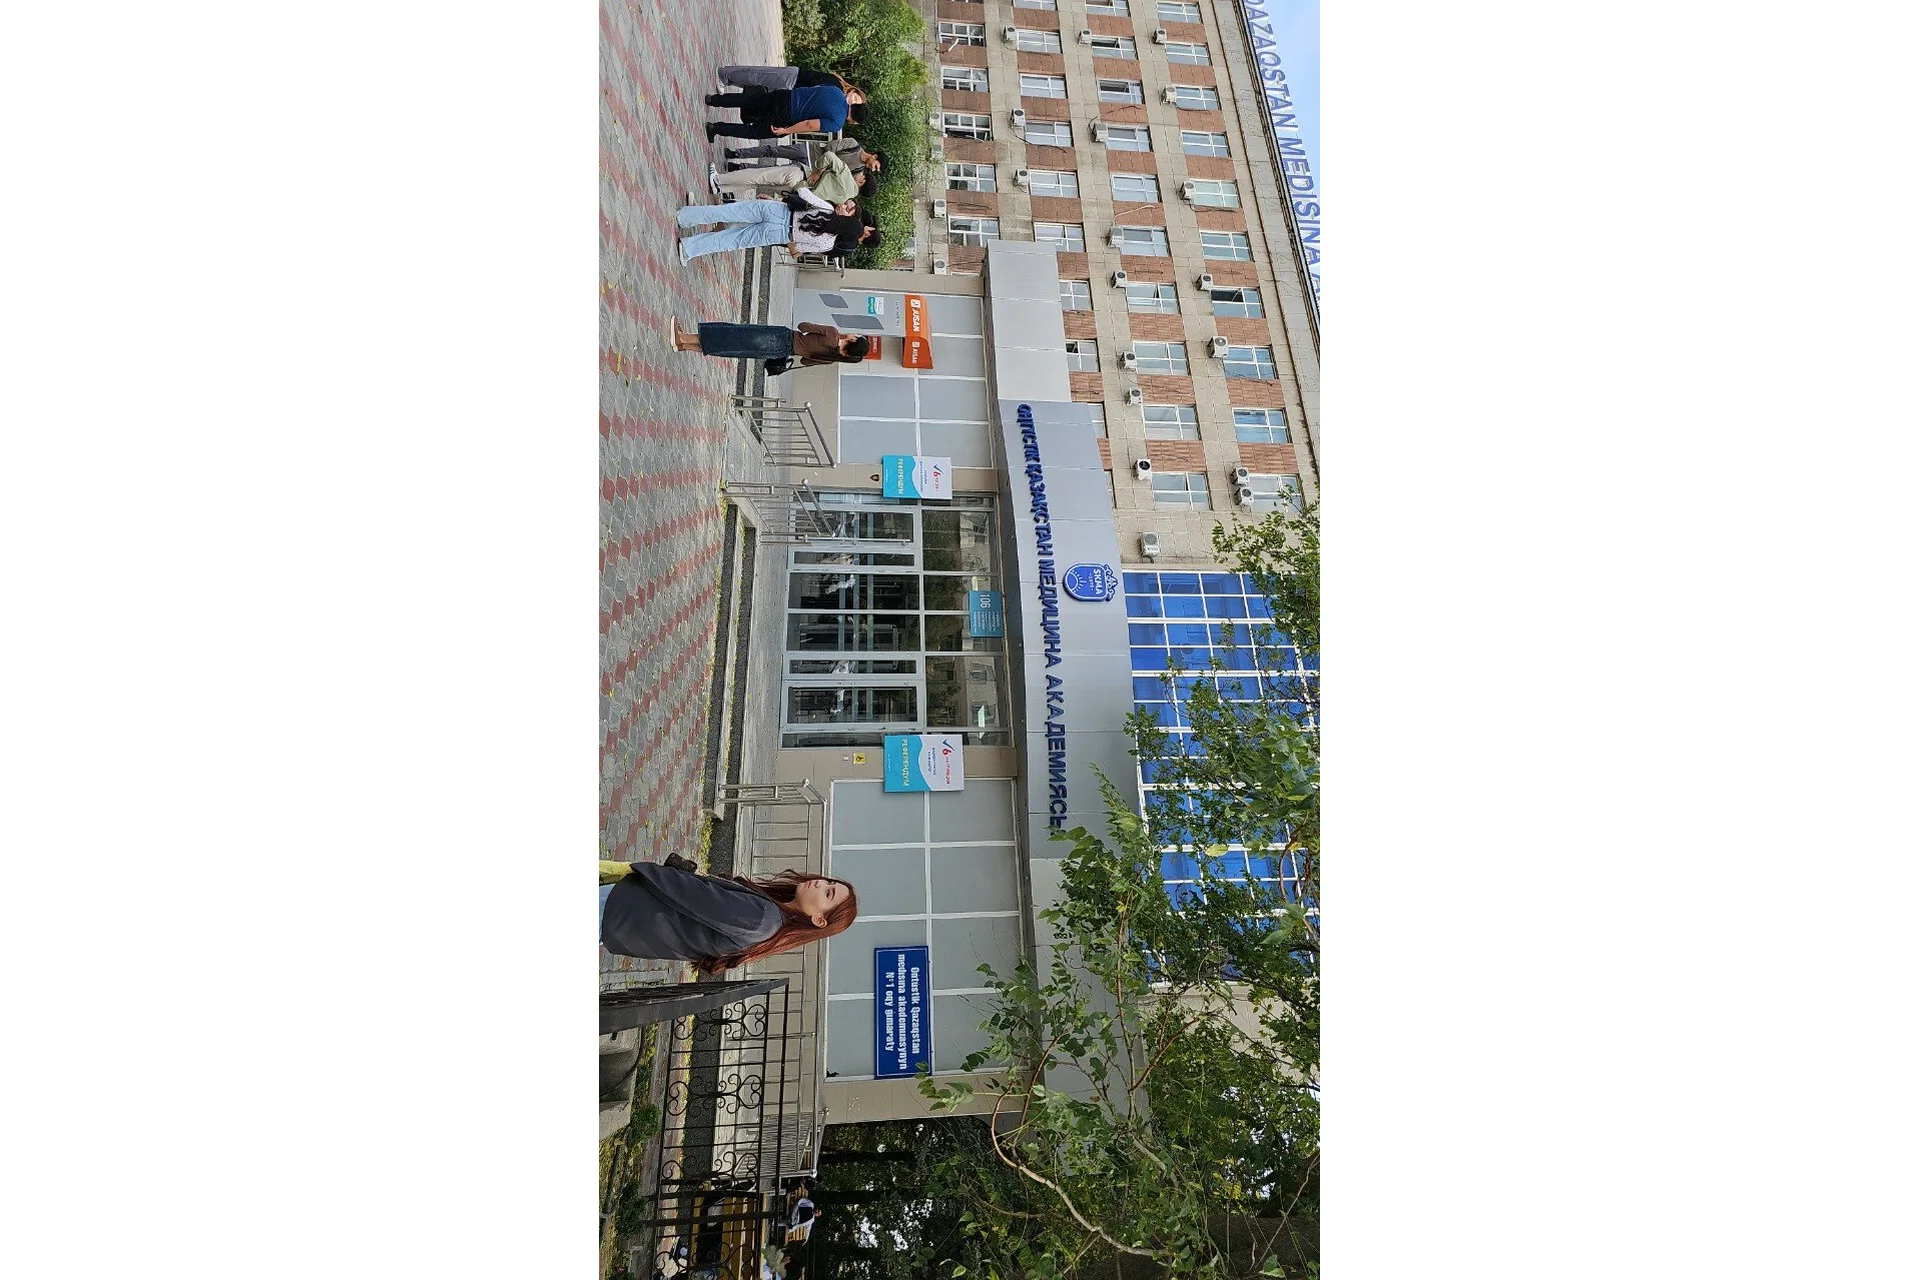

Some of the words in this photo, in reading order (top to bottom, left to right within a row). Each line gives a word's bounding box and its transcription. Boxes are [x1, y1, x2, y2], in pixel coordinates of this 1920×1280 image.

[912, 308, 920, 332] JUSAN
[1025, 464, 1054, 556] ҚАЗАҚСТАН
[980, 594, 991, 608] 106
[1094, 568, 1103, 594] SKMA
[1038, 559, 1062, 669] МЕДИЦИНА
[901, 738, 910, 787] РЕФЕРЕНДУМ
[910, 1006, 920, 1054] Qazaqstan
